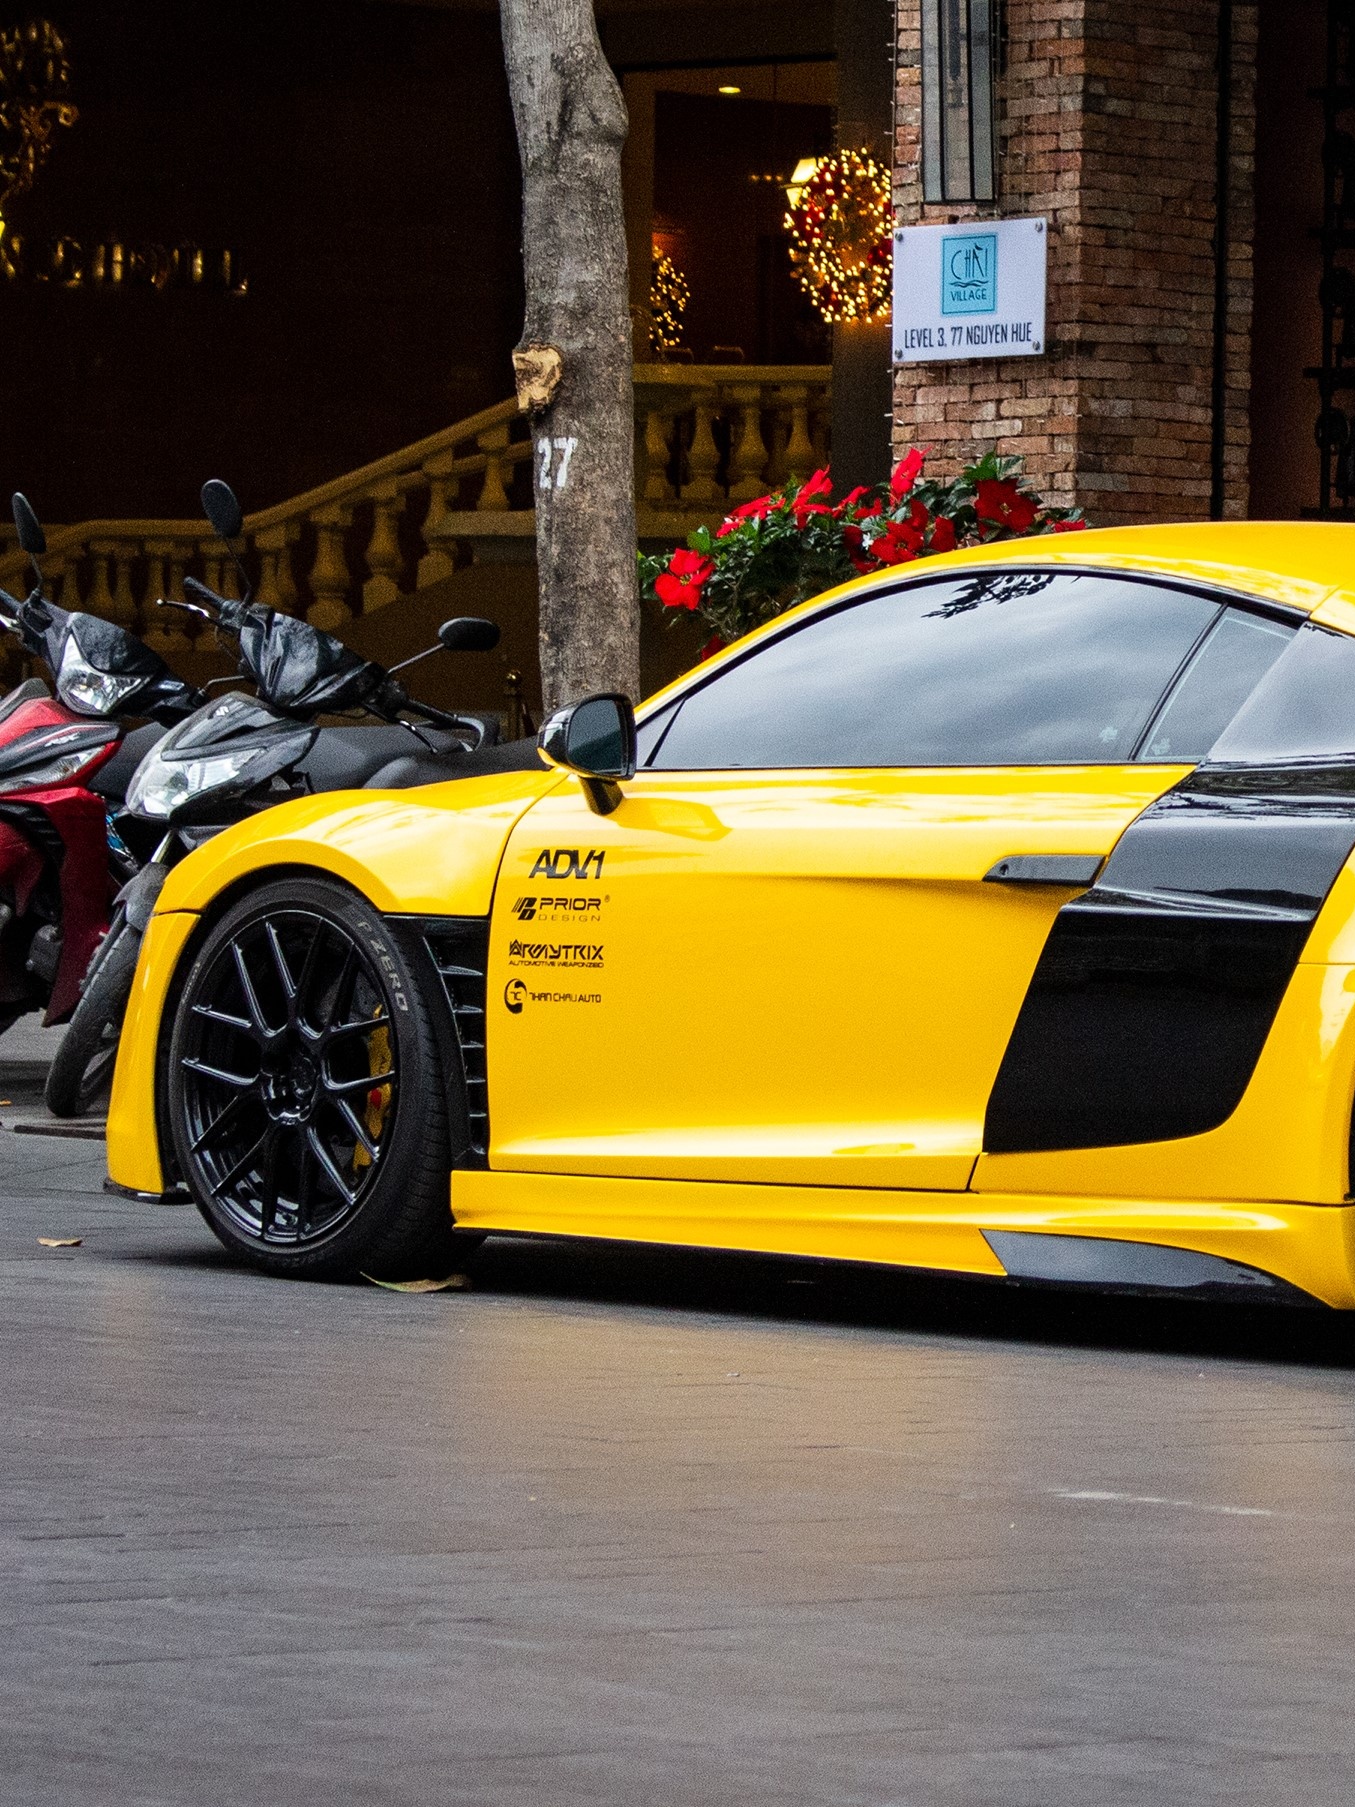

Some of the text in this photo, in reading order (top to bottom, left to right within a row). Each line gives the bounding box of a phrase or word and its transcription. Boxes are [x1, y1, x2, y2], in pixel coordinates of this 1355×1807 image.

[950, 288, 987, 301] VILLAGE
[904, 328, 934, 348] LEVEL
[951, 326, 963, 346] 77
[966, 323, 1008, 345] NGUYEN
[1011, 322, 1032, 342] HUE
[538, 437, 578, 489] 27
[540, 897, 602, 911] PRIOR
[538, 914, 601, 922] DESIGN
[578, 994, 601, 1003] AUTO
